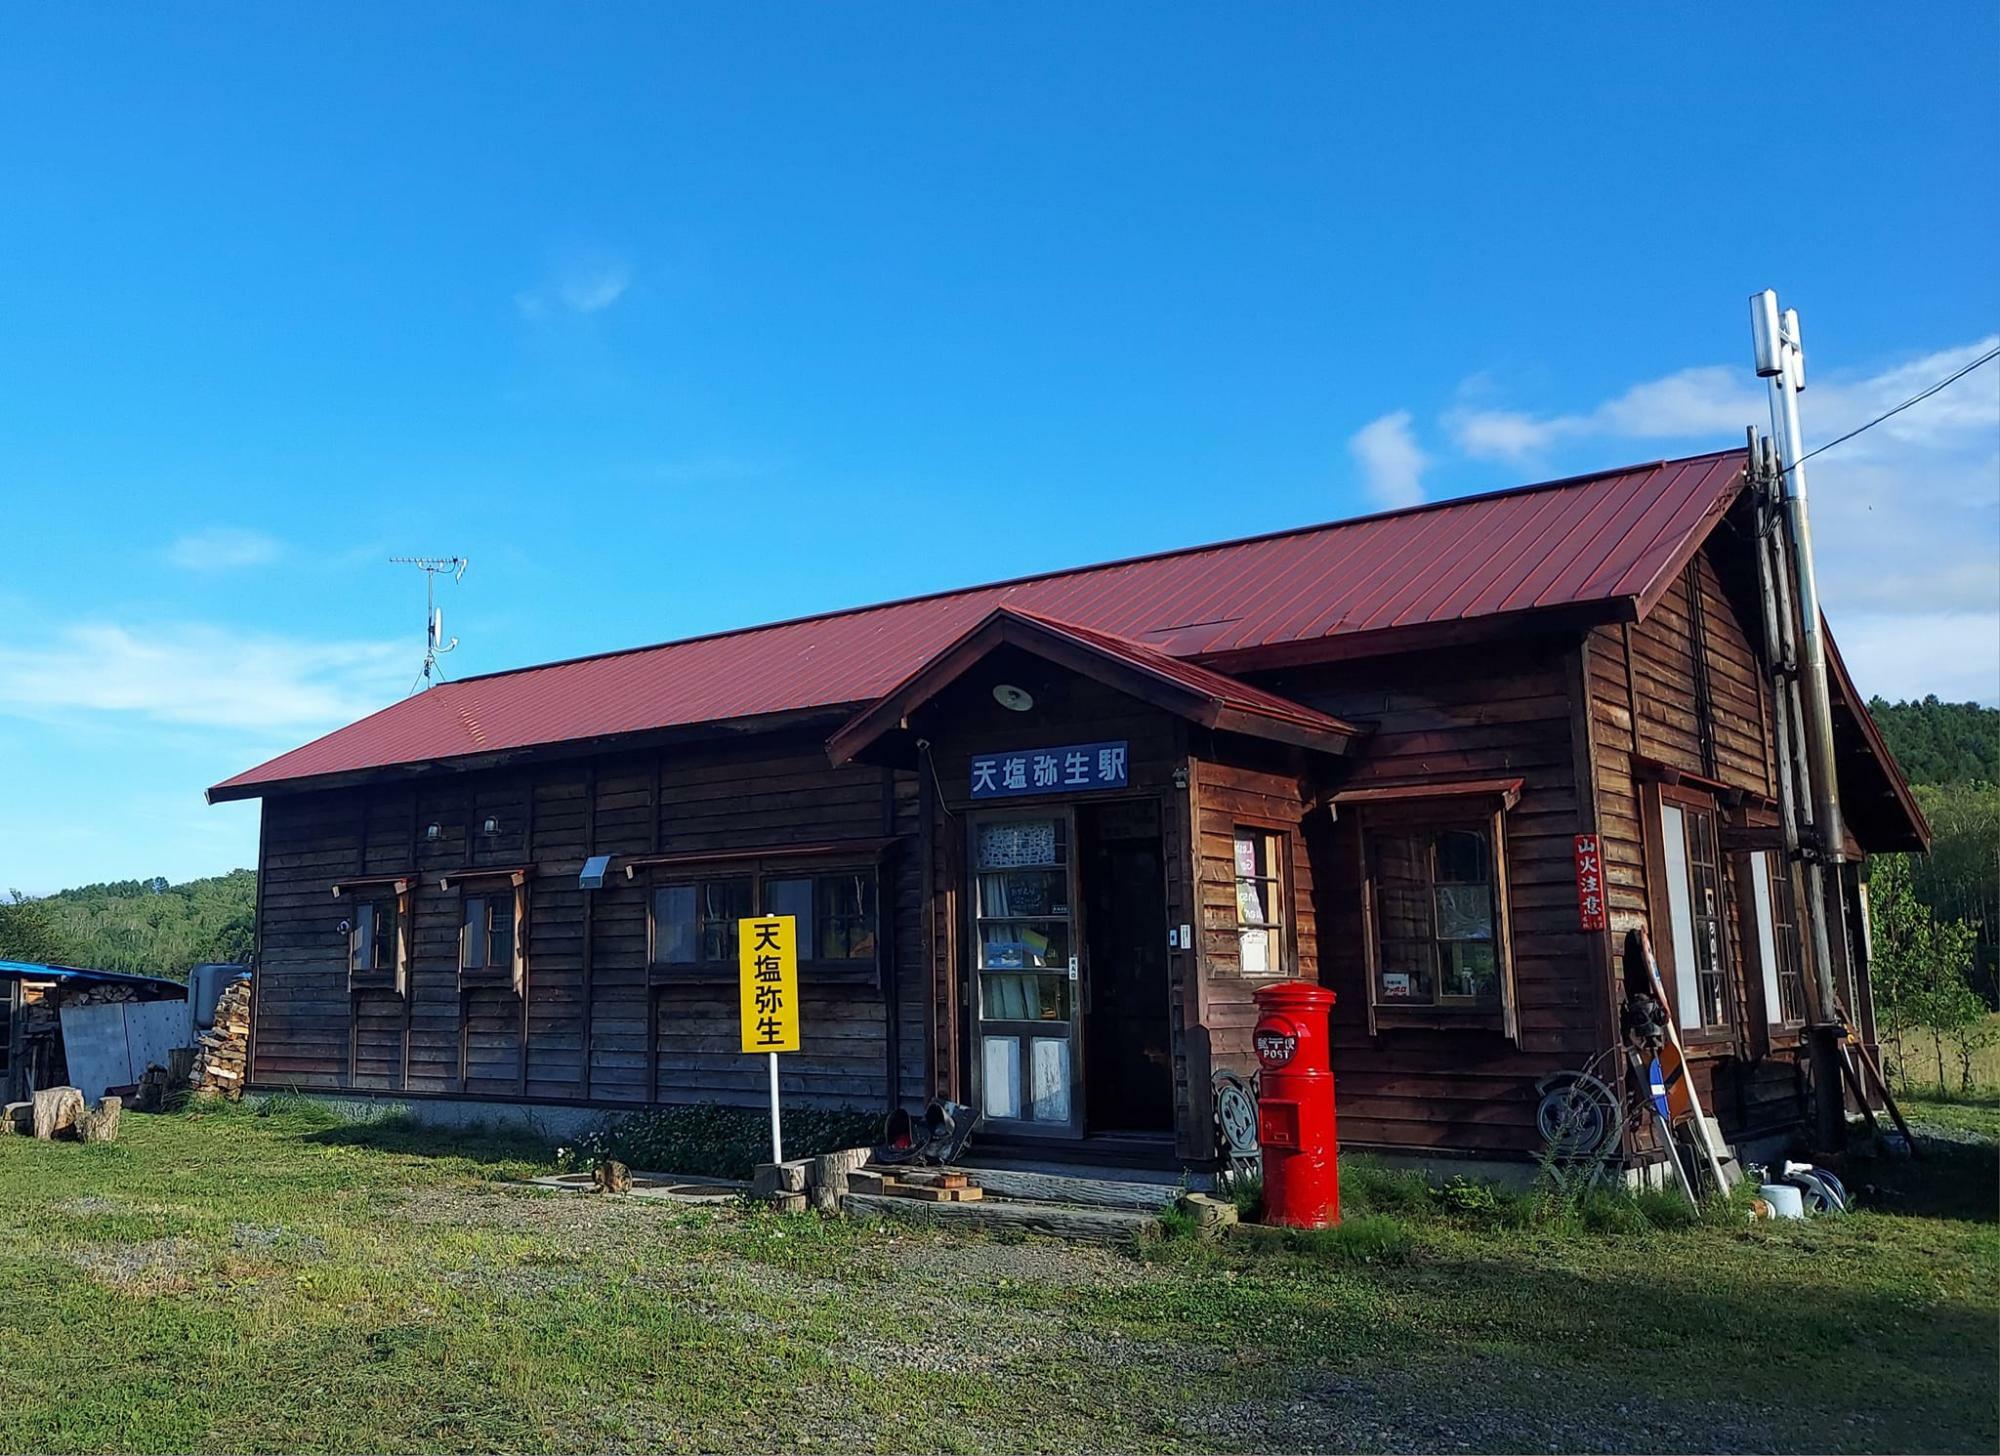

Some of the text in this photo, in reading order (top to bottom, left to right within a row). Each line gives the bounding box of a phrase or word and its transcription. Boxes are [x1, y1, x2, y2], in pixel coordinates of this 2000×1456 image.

[972, 747, 1125, 793] 天塩弥生駅
[1577, 838, 1602, 916] 山火注意
[754, 923, 785, 1046] 天塩弥生
[1263, 1049, 1290, 1060] POST
